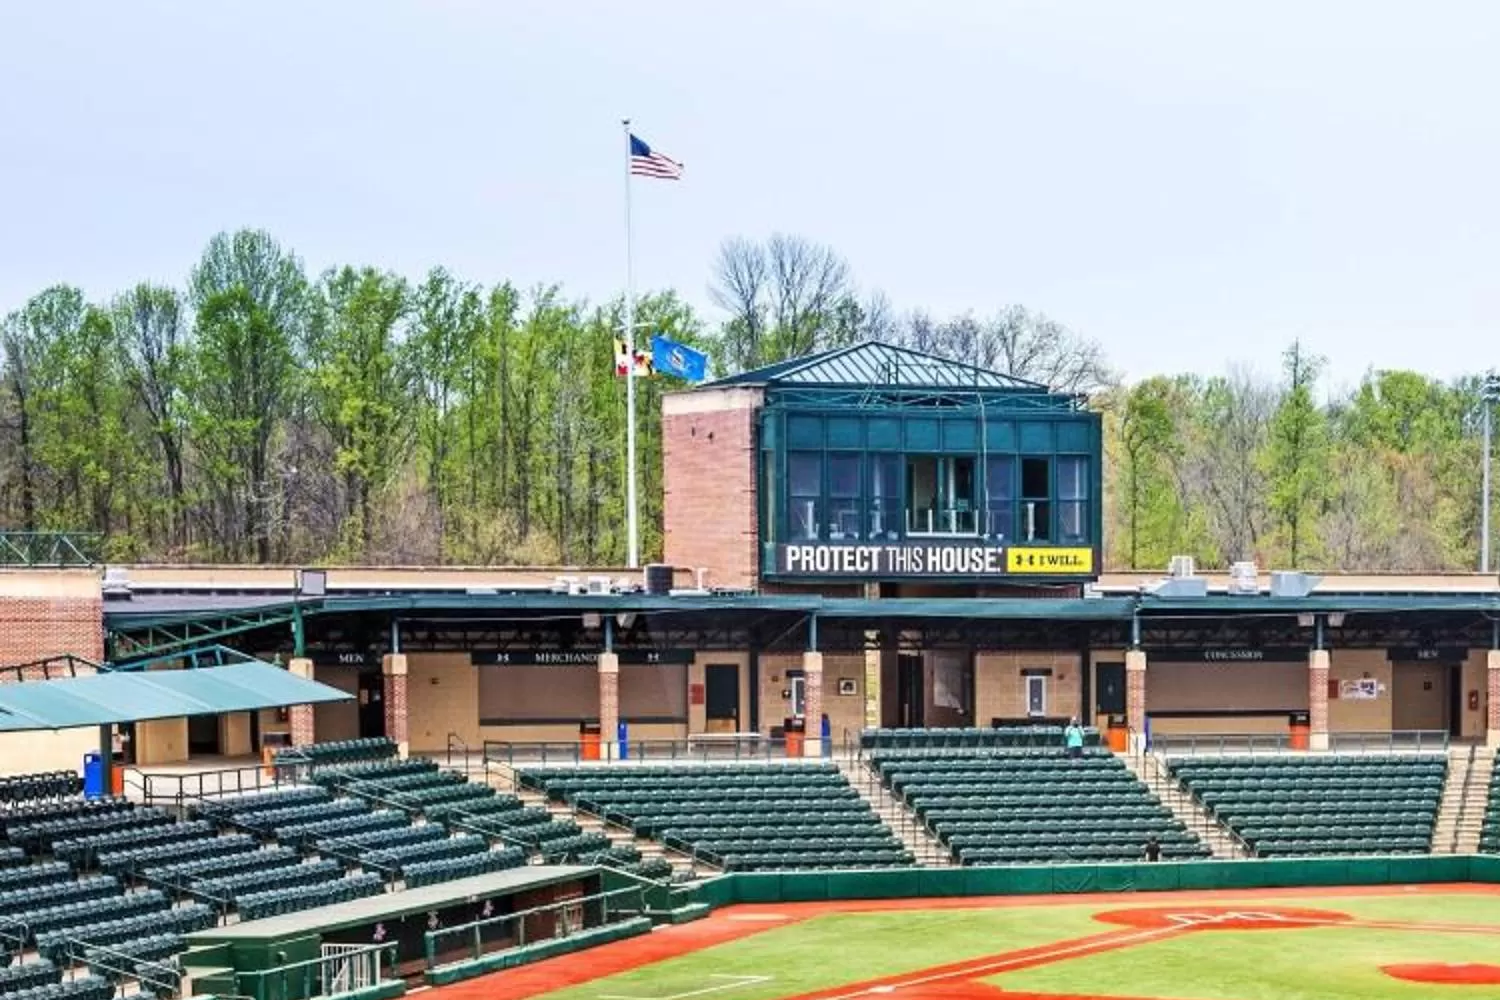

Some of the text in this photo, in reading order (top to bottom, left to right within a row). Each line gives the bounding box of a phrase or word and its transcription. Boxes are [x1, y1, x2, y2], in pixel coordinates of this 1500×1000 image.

[786, 545, 881, 572] PROTECT
[886, 547, 924, 572] THIS
[338, 653, 364, 664] MEN
[535, 652, 598, 664] MERCHAND
